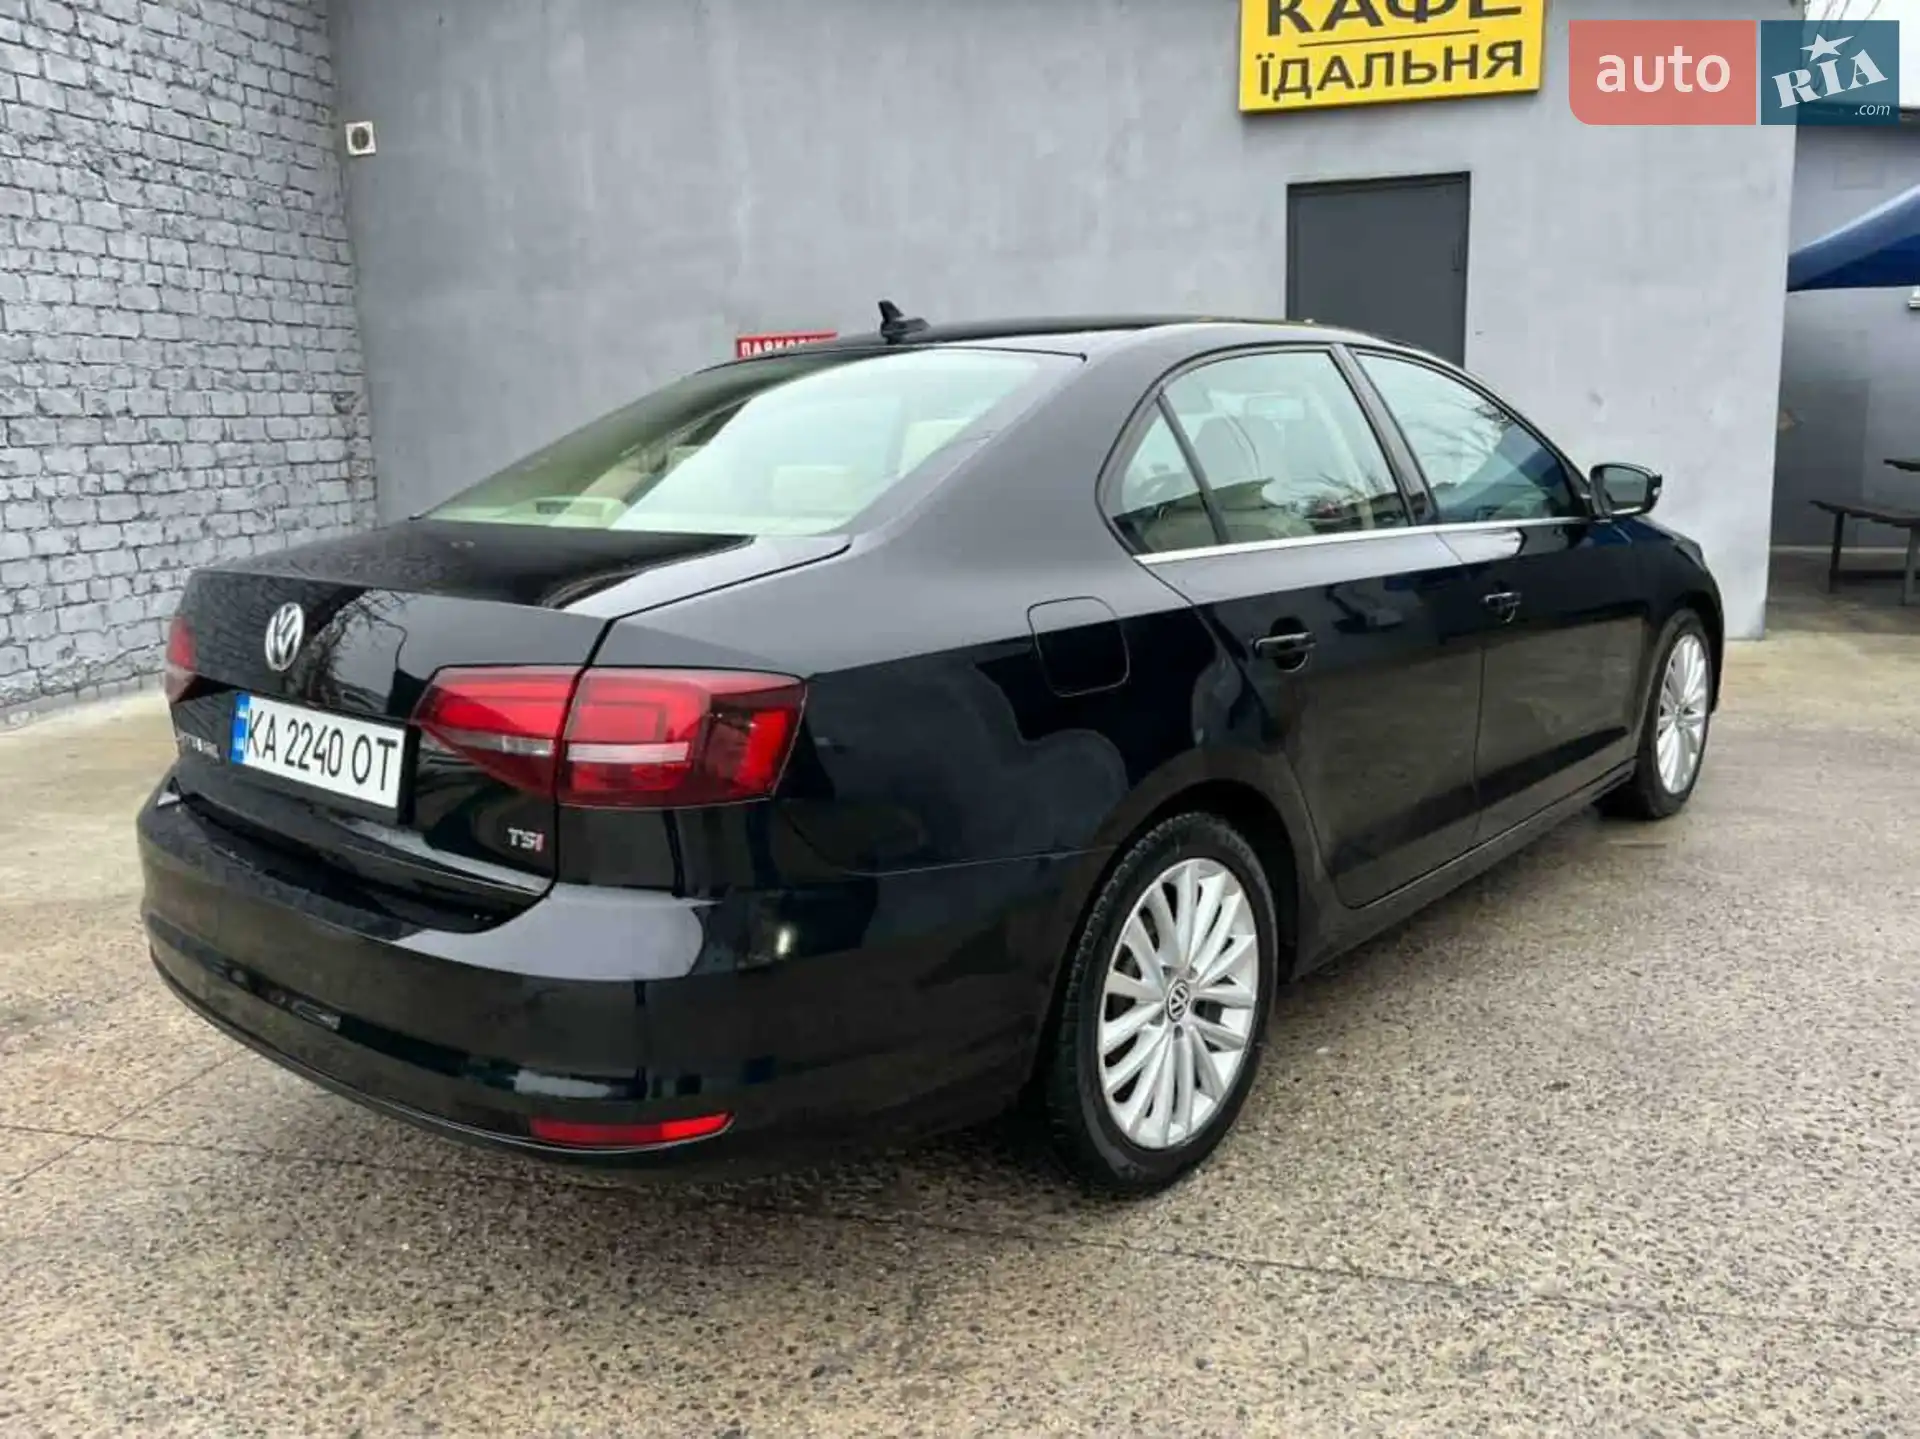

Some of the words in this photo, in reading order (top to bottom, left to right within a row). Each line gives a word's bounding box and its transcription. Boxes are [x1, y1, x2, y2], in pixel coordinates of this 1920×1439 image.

[1256, 40, 1523, 101] ЇДАЛЬНЯ
[247, 707, 277, 762] KA
[284, 718, 344, 777] 2240
[352, 734, 398, 791] OT
